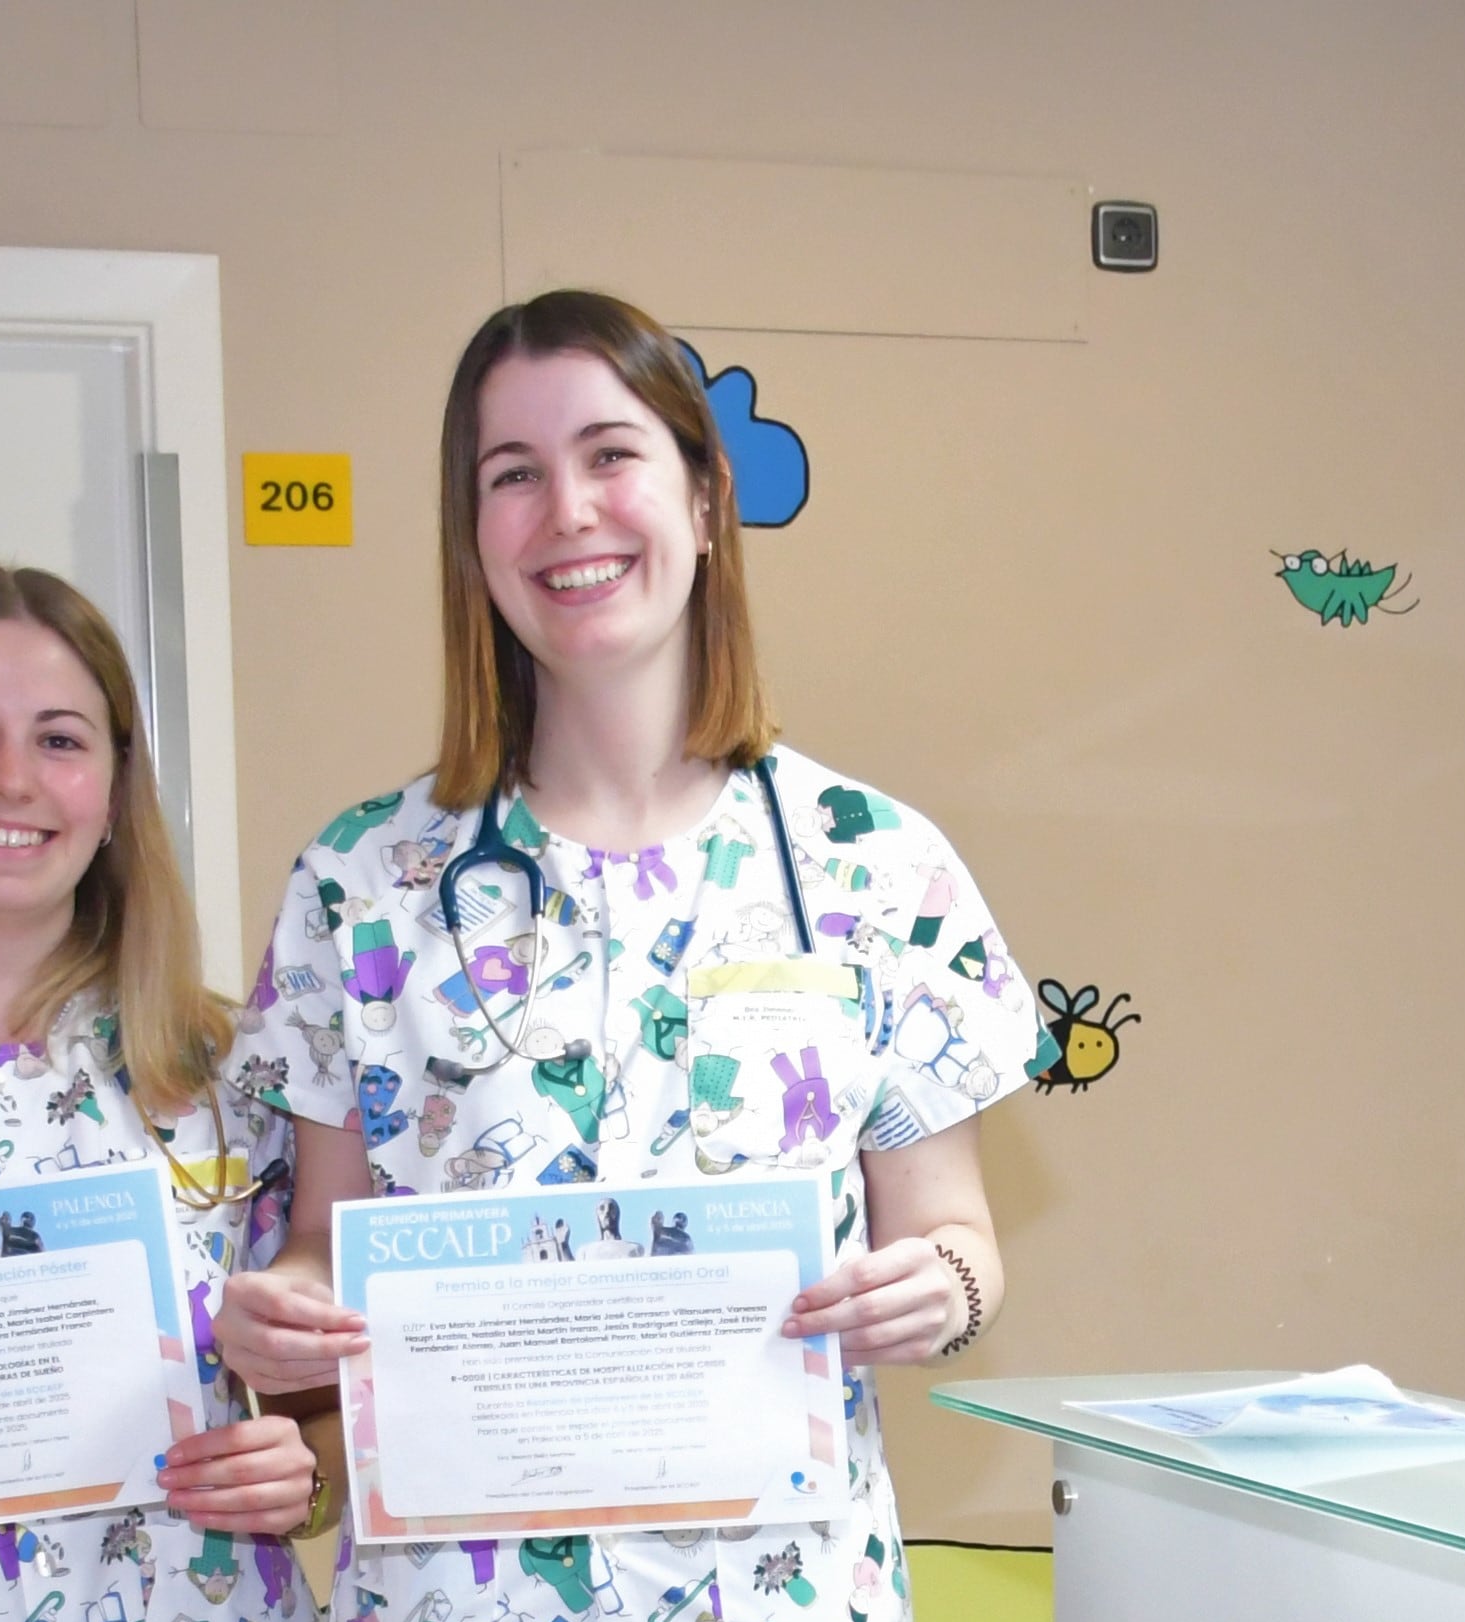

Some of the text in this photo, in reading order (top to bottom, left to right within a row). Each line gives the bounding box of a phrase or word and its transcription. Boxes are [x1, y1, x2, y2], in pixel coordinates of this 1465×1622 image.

[260, 480, 334, 511] 206
[51, 1189, 135, 1216] PALENCIA
[705, 1198, 792, 1220] PALENCIA
[367, 1222, 513, 1263] SCCALP
[39, 1259, 87, 1276] Póster
[436, 1281, 490, 1292] Premio
[509, 1277, 522, 1288] la
[527, 1274, 573, 1290] mejor
[577, 1267, 692, 1285] Comunicación
[696, 1264, 728, 1278] Oral
